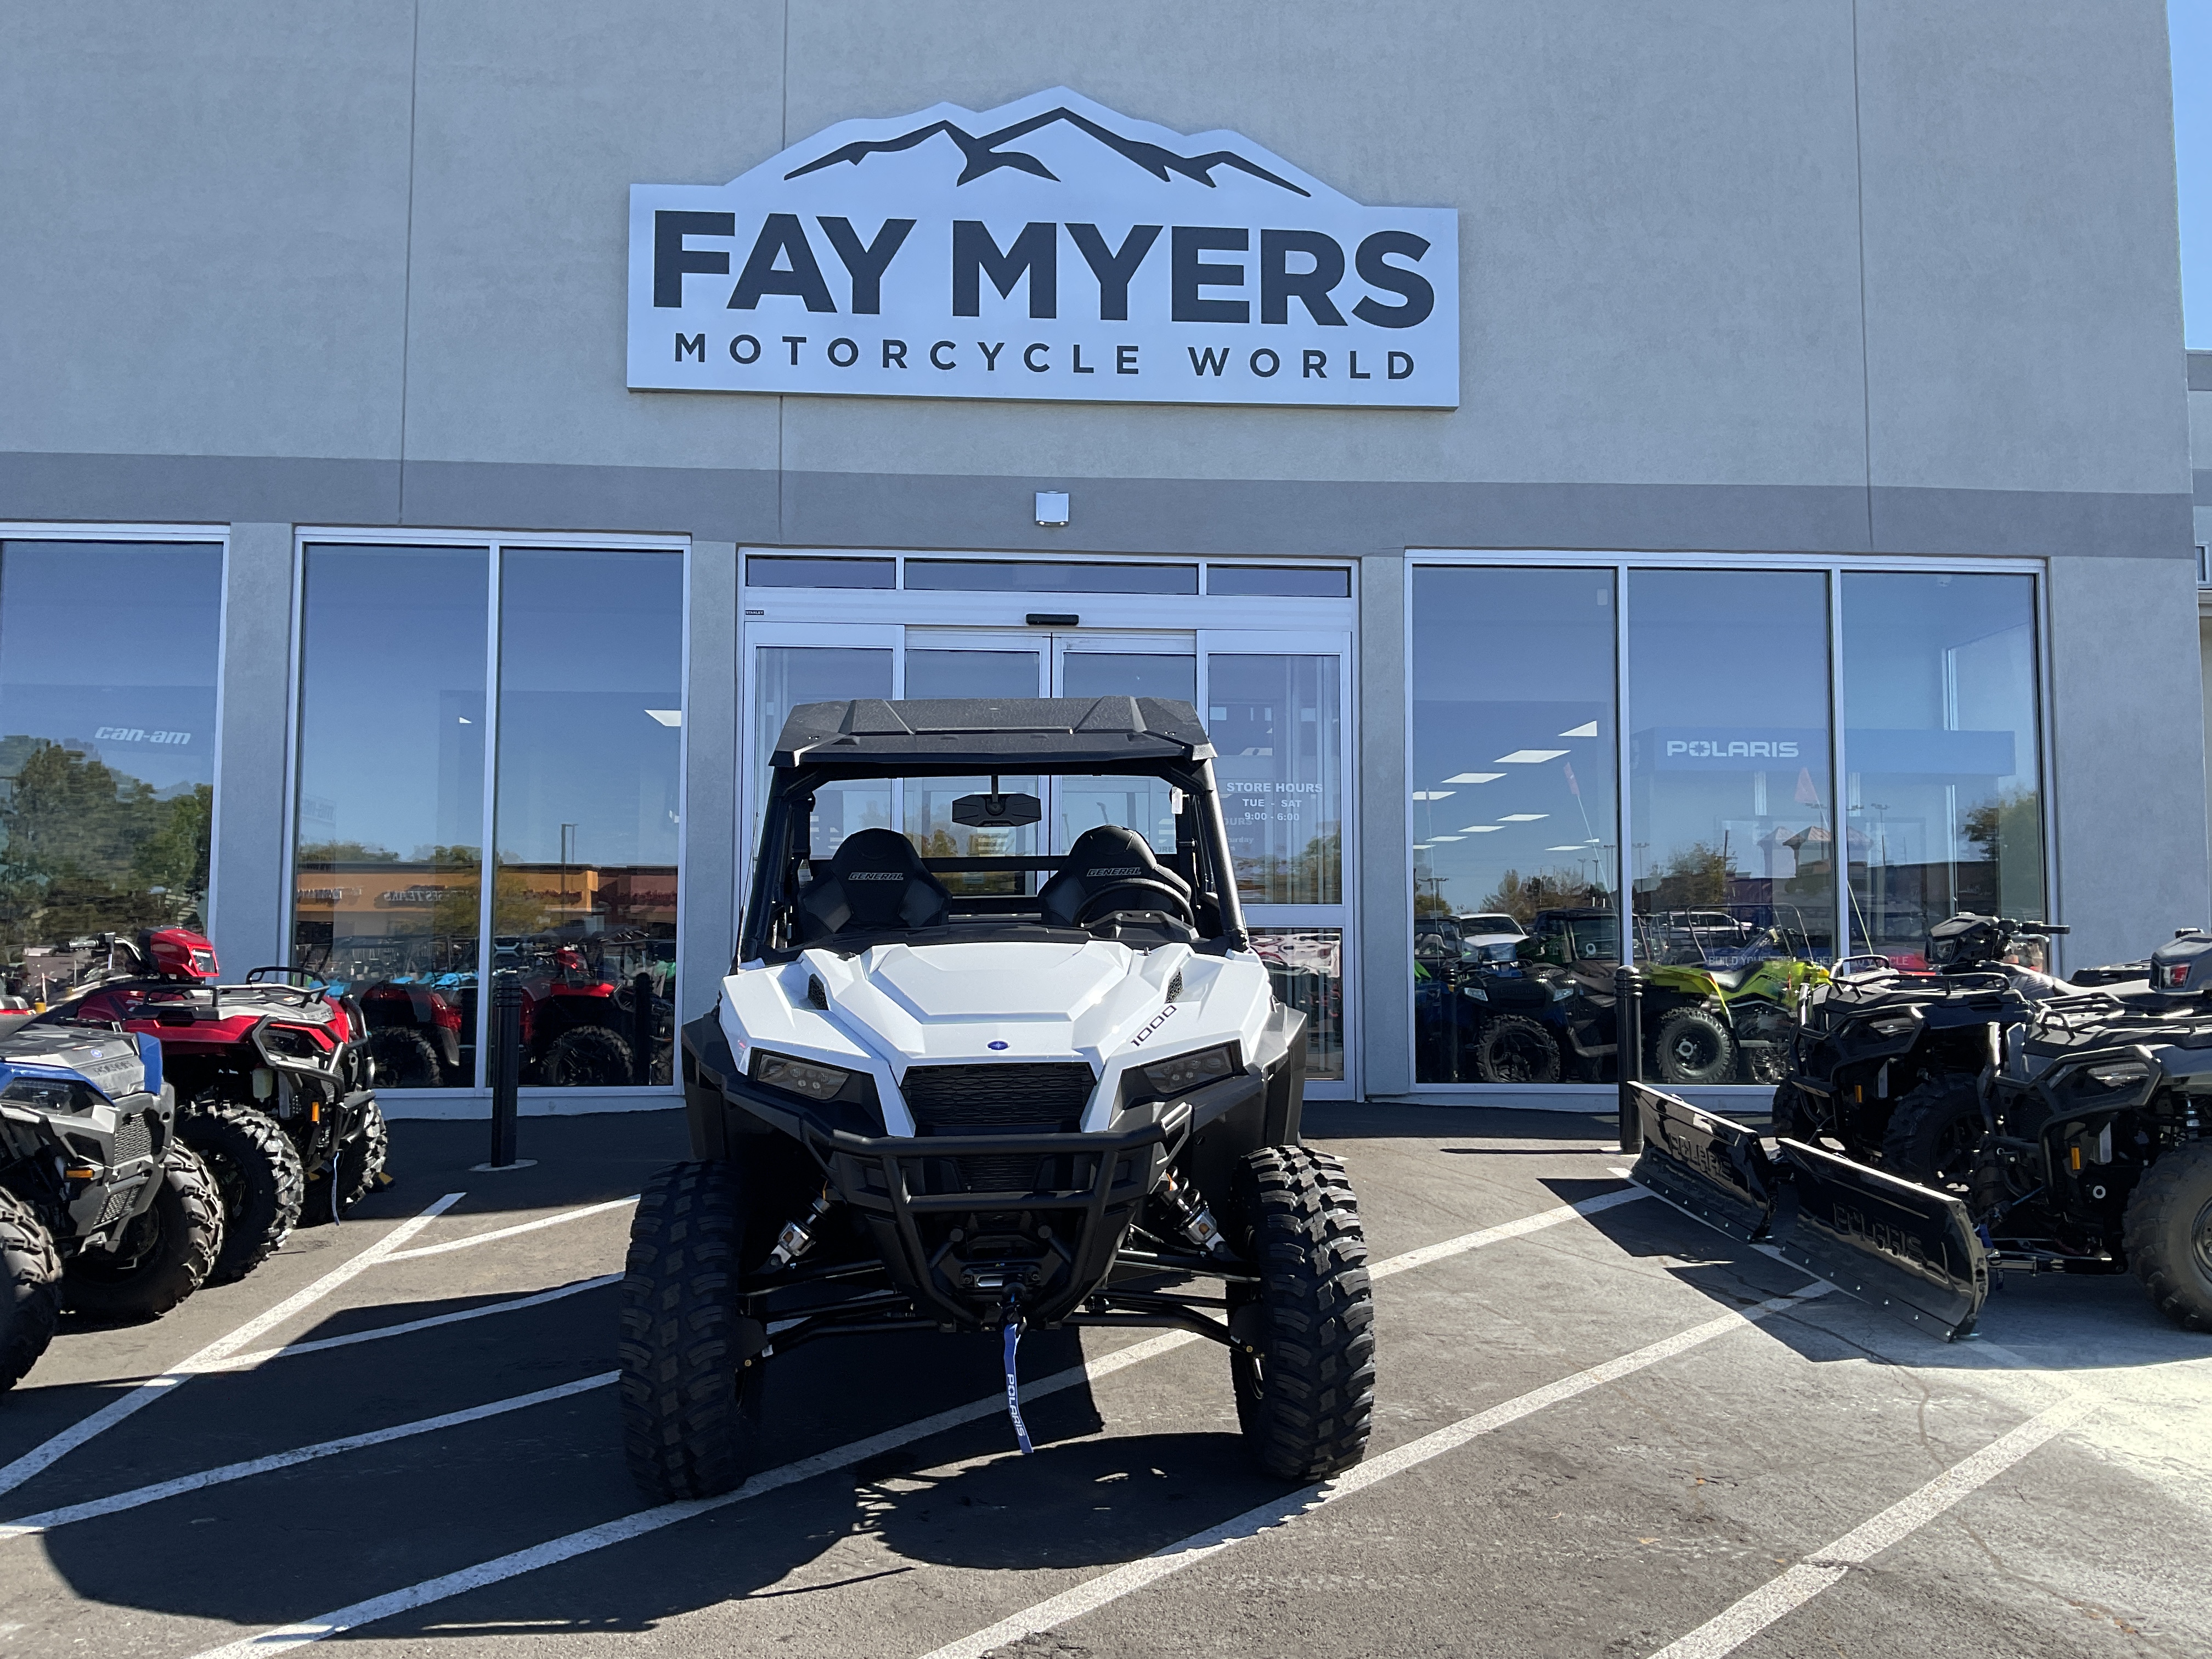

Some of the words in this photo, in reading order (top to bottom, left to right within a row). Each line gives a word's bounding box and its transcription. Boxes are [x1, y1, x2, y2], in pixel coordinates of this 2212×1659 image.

[653, 210, 917, 315] FAY
[952, 219, 1435, 329] MYERS
[675, 332, 1139, 375] MOTORCYCLE
[1187, 347, 1414, 380] WORLD
[95, 727, 191, 744] can-am
[1667, 741, 1799, 757] POLARIS
[1226, 782, 1271, 792] STORE
[1276, 783, 1323, 793] HOURS
[1242, 799, 1265, 807] TUE
[1281, 799, 1302, 808] SAT
[1224, 817, 1252, 826] OURS
[1244, 812, 1267, 820] 9:00
[1087, 867, 1141, 877] GENERAL
[1708, 956, 1739, 966] BUILD
[1131, 1005, 1177, 1047] 1000
[1007, 1374, 1025, 1436] POLARIS
